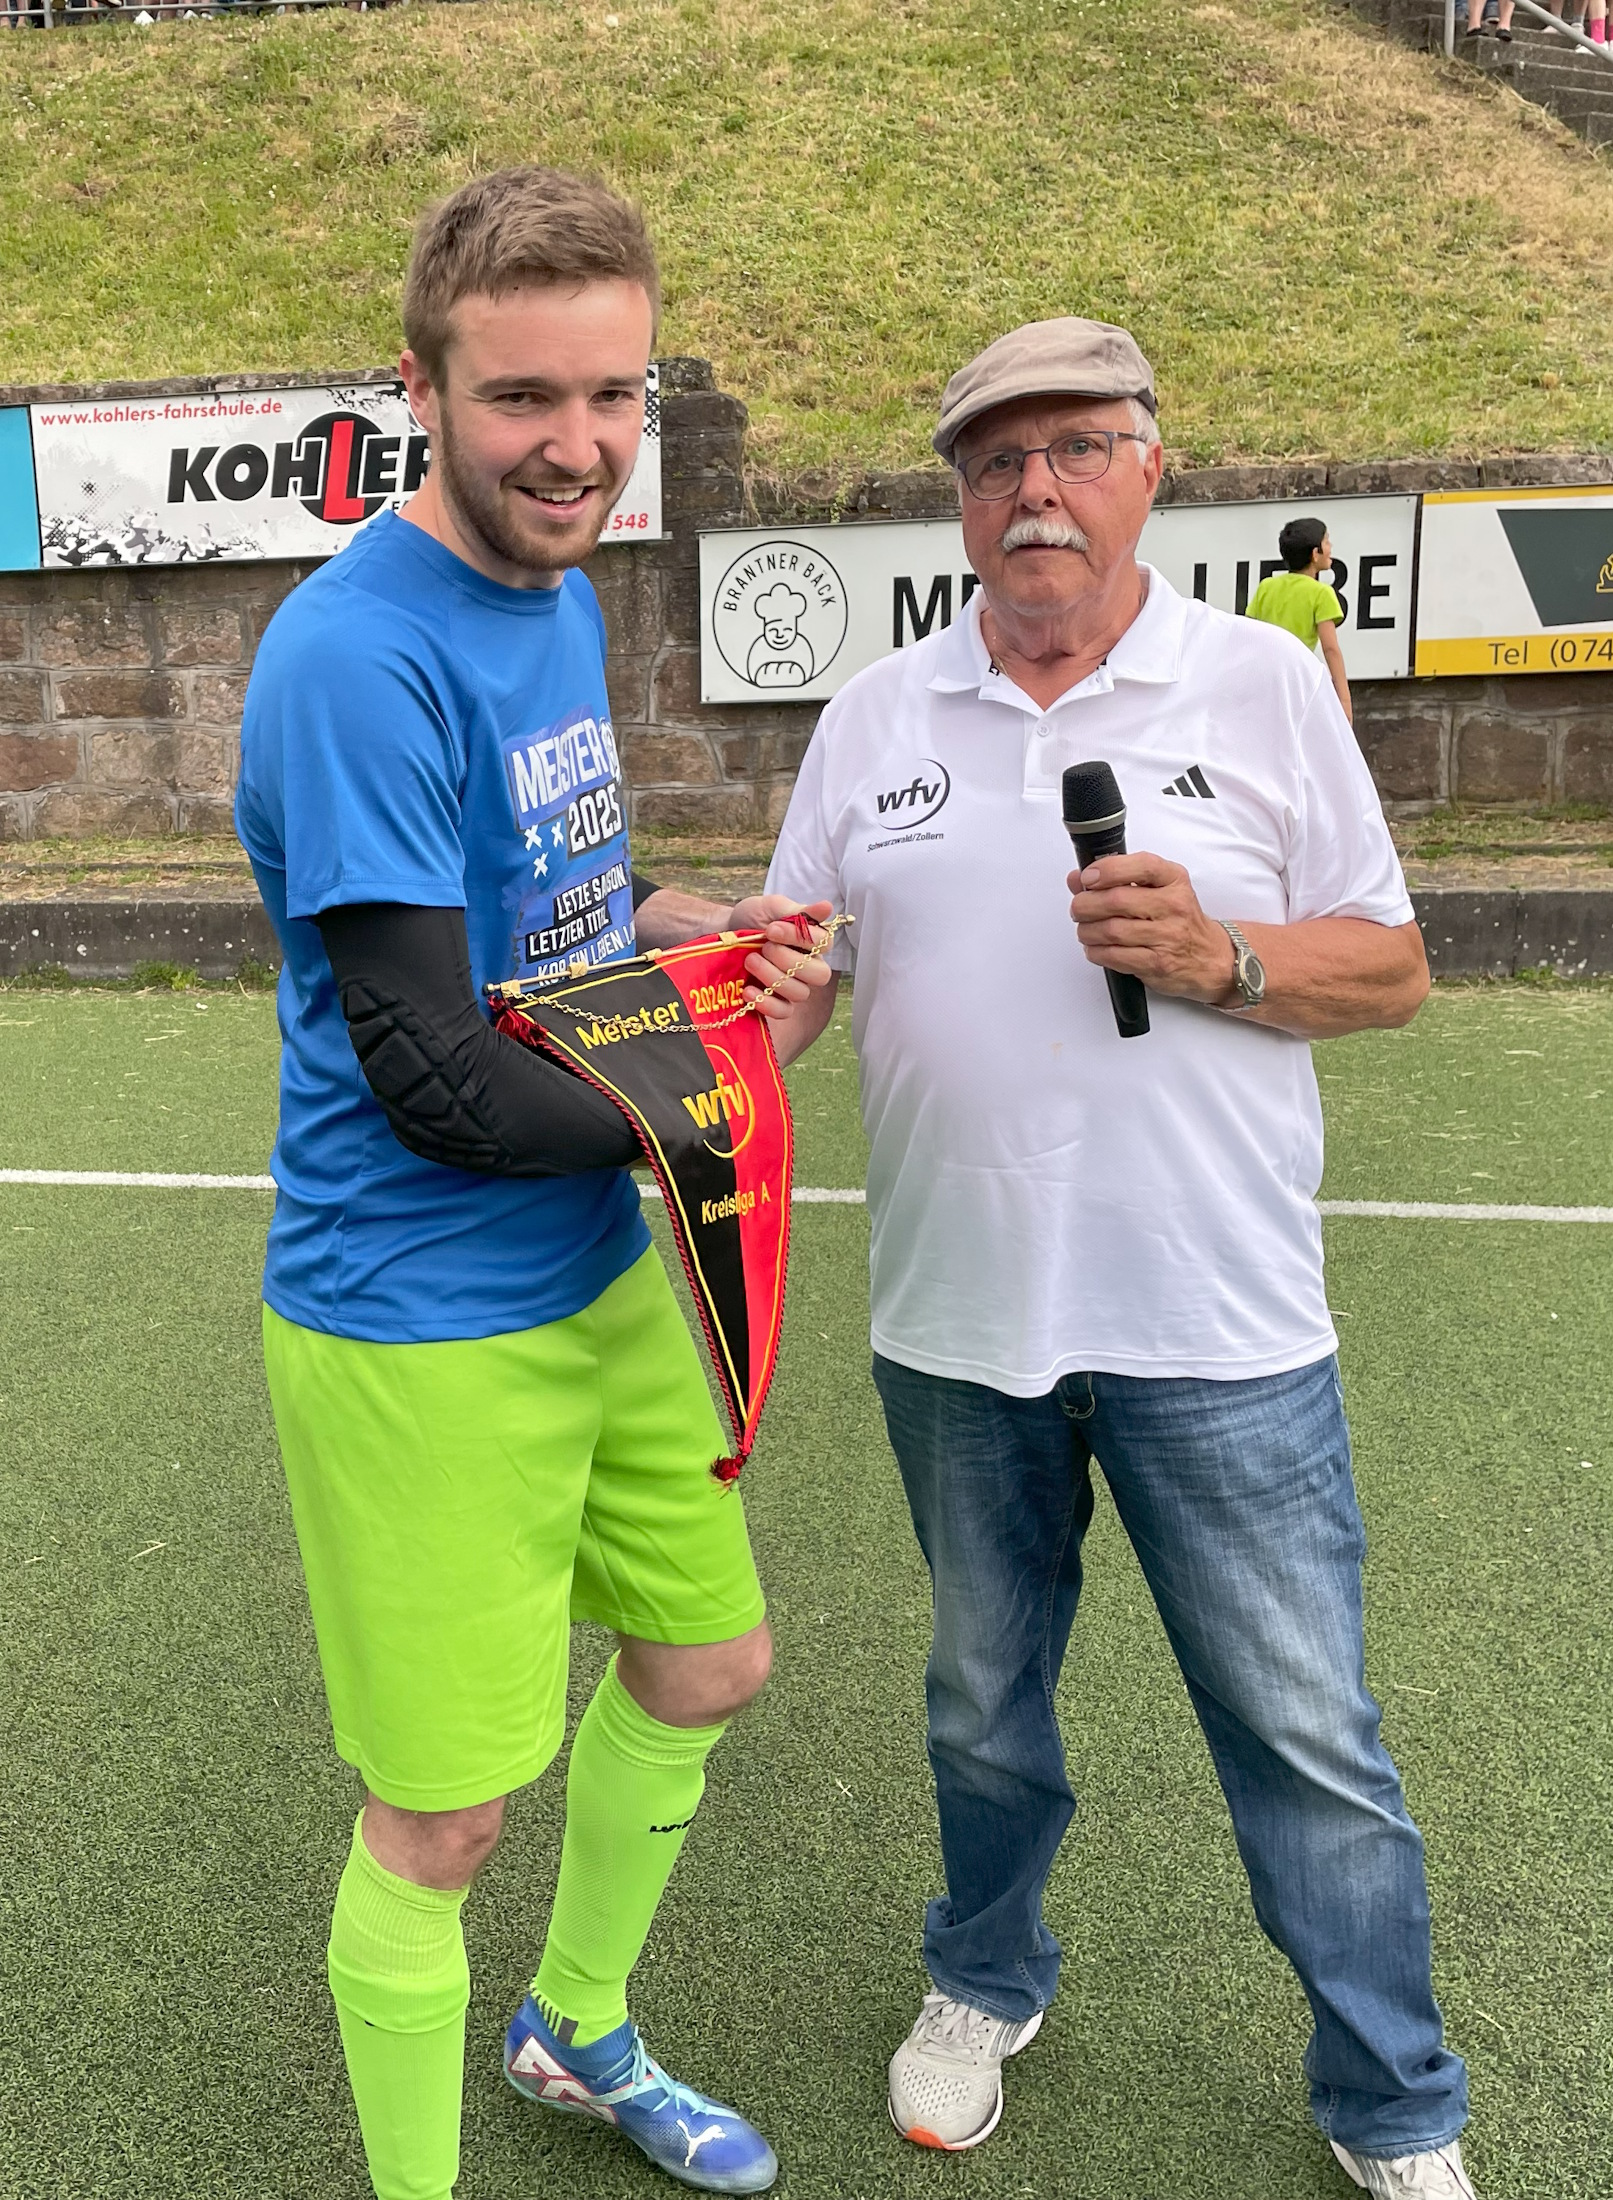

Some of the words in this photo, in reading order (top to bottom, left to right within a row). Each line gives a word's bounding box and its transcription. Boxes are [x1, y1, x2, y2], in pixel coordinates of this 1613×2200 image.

[40, 398, 283, 426] www.kohlers-fahrschule.de
[723, 553, 799, 612] BRANTNER
[803, 562, 837, 608] BÄCK
[1488, 640, 1528, 666] Tel
[512, 717, 609, 813] MEISTER
[568, 786, 623, 853] 2025
[876, 776, 942, 814] wfv
[866, 832, 944, 852] Schwarzwald/Zollern
[575, 1001, 680, 1050] Meister
[689, 979, 745, 1015] 2024/25
[681, 1072, 746, 1129] wfv
[701, 1190, 756, 1225] Kreisliga
[761, 1180, 772, 1205] A
